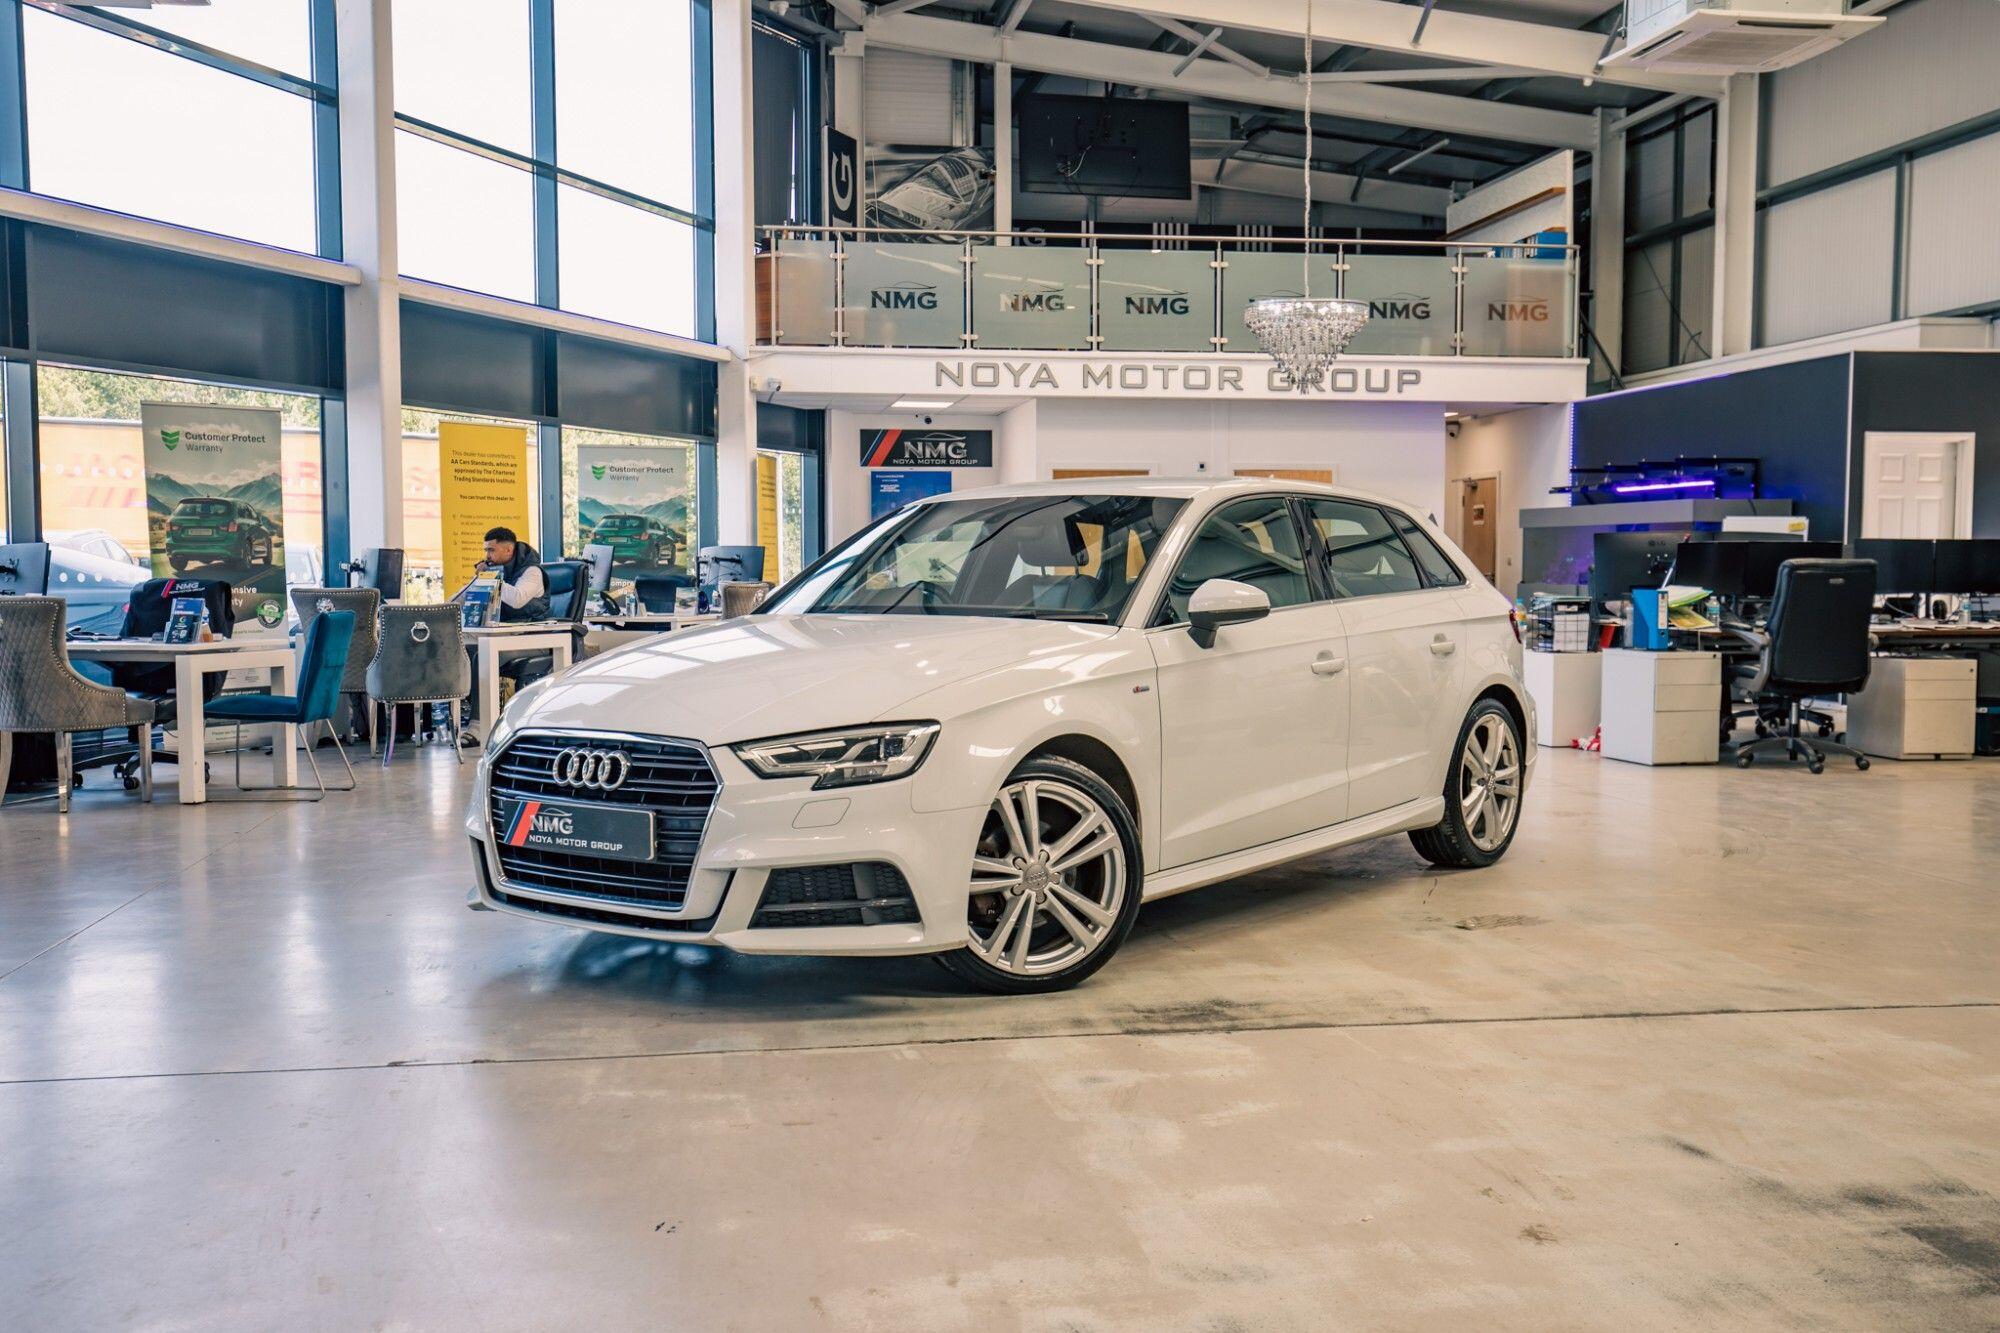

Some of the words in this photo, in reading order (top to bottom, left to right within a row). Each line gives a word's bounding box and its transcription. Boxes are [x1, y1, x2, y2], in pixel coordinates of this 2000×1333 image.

[871, 290, 938, 309] NMG
[999, 293, 1065, 312] NMG
[1125, 296, 1189, 315] NMG
[1369, 301, 1431, 320] NMG
[1488, 303, 1549, 321] NMG
[936, 361, 1059, 389] NOYA
[1082, 364, 1244, 391] MOTOR
[185, 431, 229, 442] Customer
[232, 433, 266, 443] Protect
[186, 443, 223, 454] Warranty
[904, 441, 967, 459] NMG
[609, 465, 645, 473] Customer
[647, 466, 674, 474] Protect
[610, 474, 639, 482] Warranty
[176, 582, 199, 590] NMG
[529, 814, 574, 835] NMG
[528, 834, 553, 844] NOYA
[556, 837, 588, 848] MOTOR
[591, 841, 623, 851] GROUP
